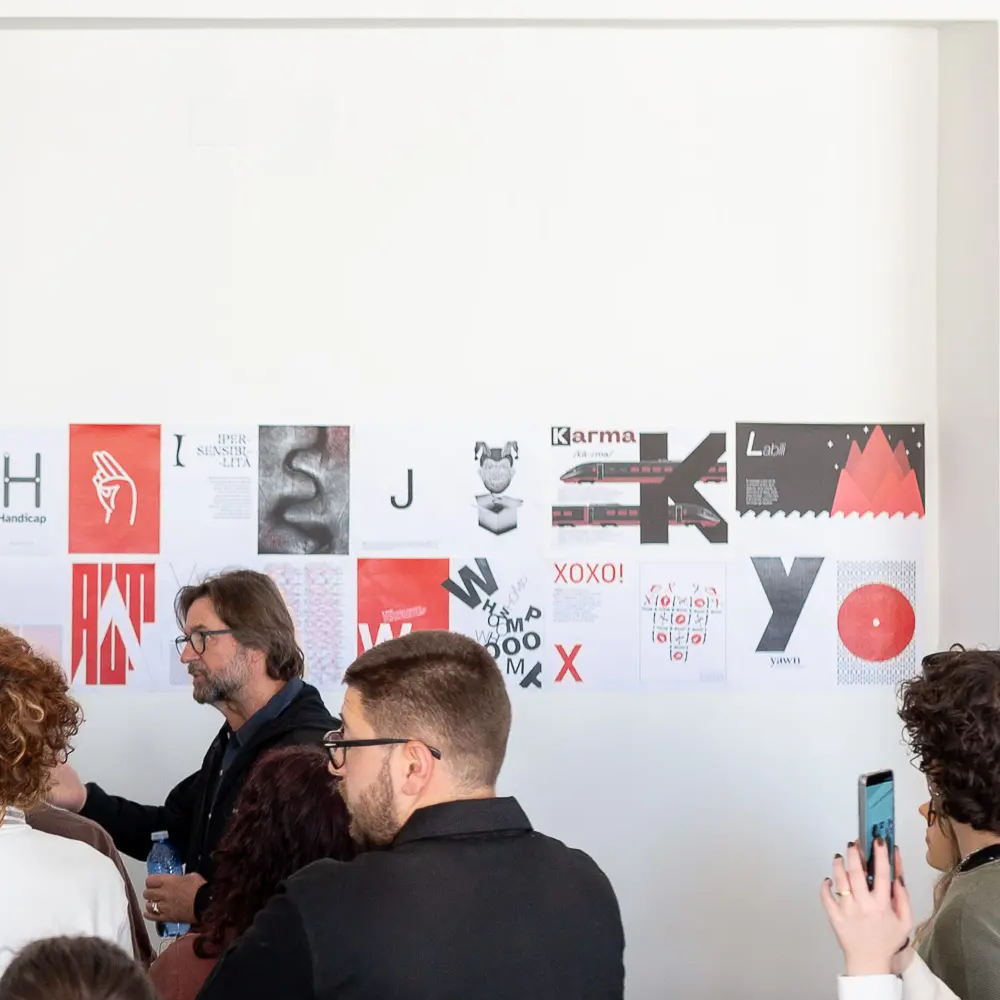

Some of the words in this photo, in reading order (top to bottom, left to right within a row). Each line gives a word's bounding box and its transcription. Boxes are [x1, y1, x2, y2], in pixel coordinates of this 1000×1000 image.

[551, 426, 636, 446] Karma
[3, 452, 41, 508] H
[390, 469, 413, 509] J
[640, 432, 728, 544] K
[554, 563, 624, 584] XOXO!
[554, 644, 582, 682] X
[770, 656, 801, 667] yawn
